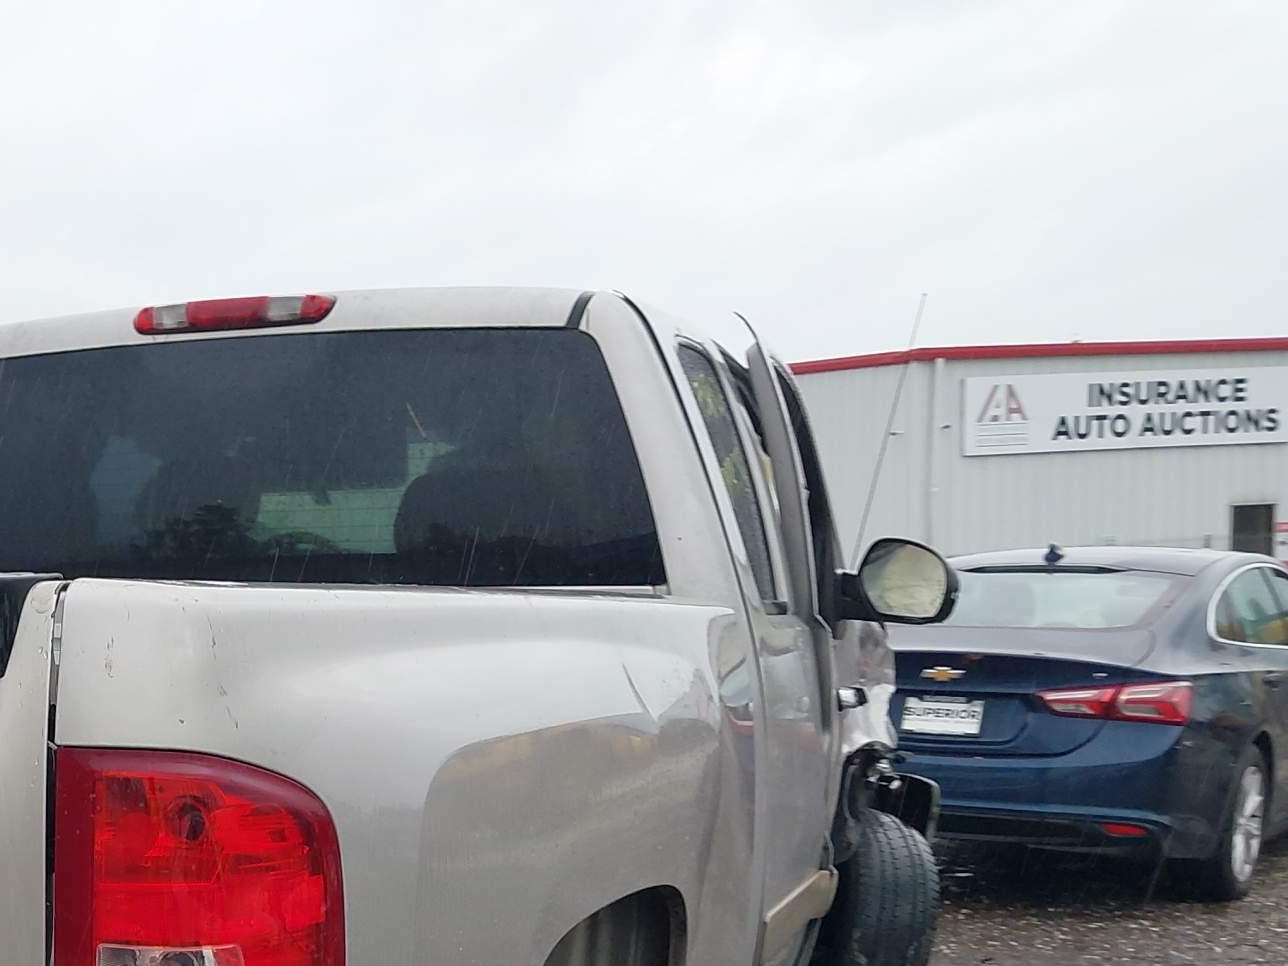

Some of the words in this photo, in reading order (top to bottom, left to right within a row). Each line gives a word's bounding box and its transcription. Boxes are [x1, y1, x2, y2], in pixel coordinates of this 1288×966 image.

[1087, 378, 1248, 407] INSURANCE
[1052, 413, 1131, 440] AUTO
[1138, 408, 1279, 437] AUCTIONS
[903, 706, 981, 720] SUPERIOR
